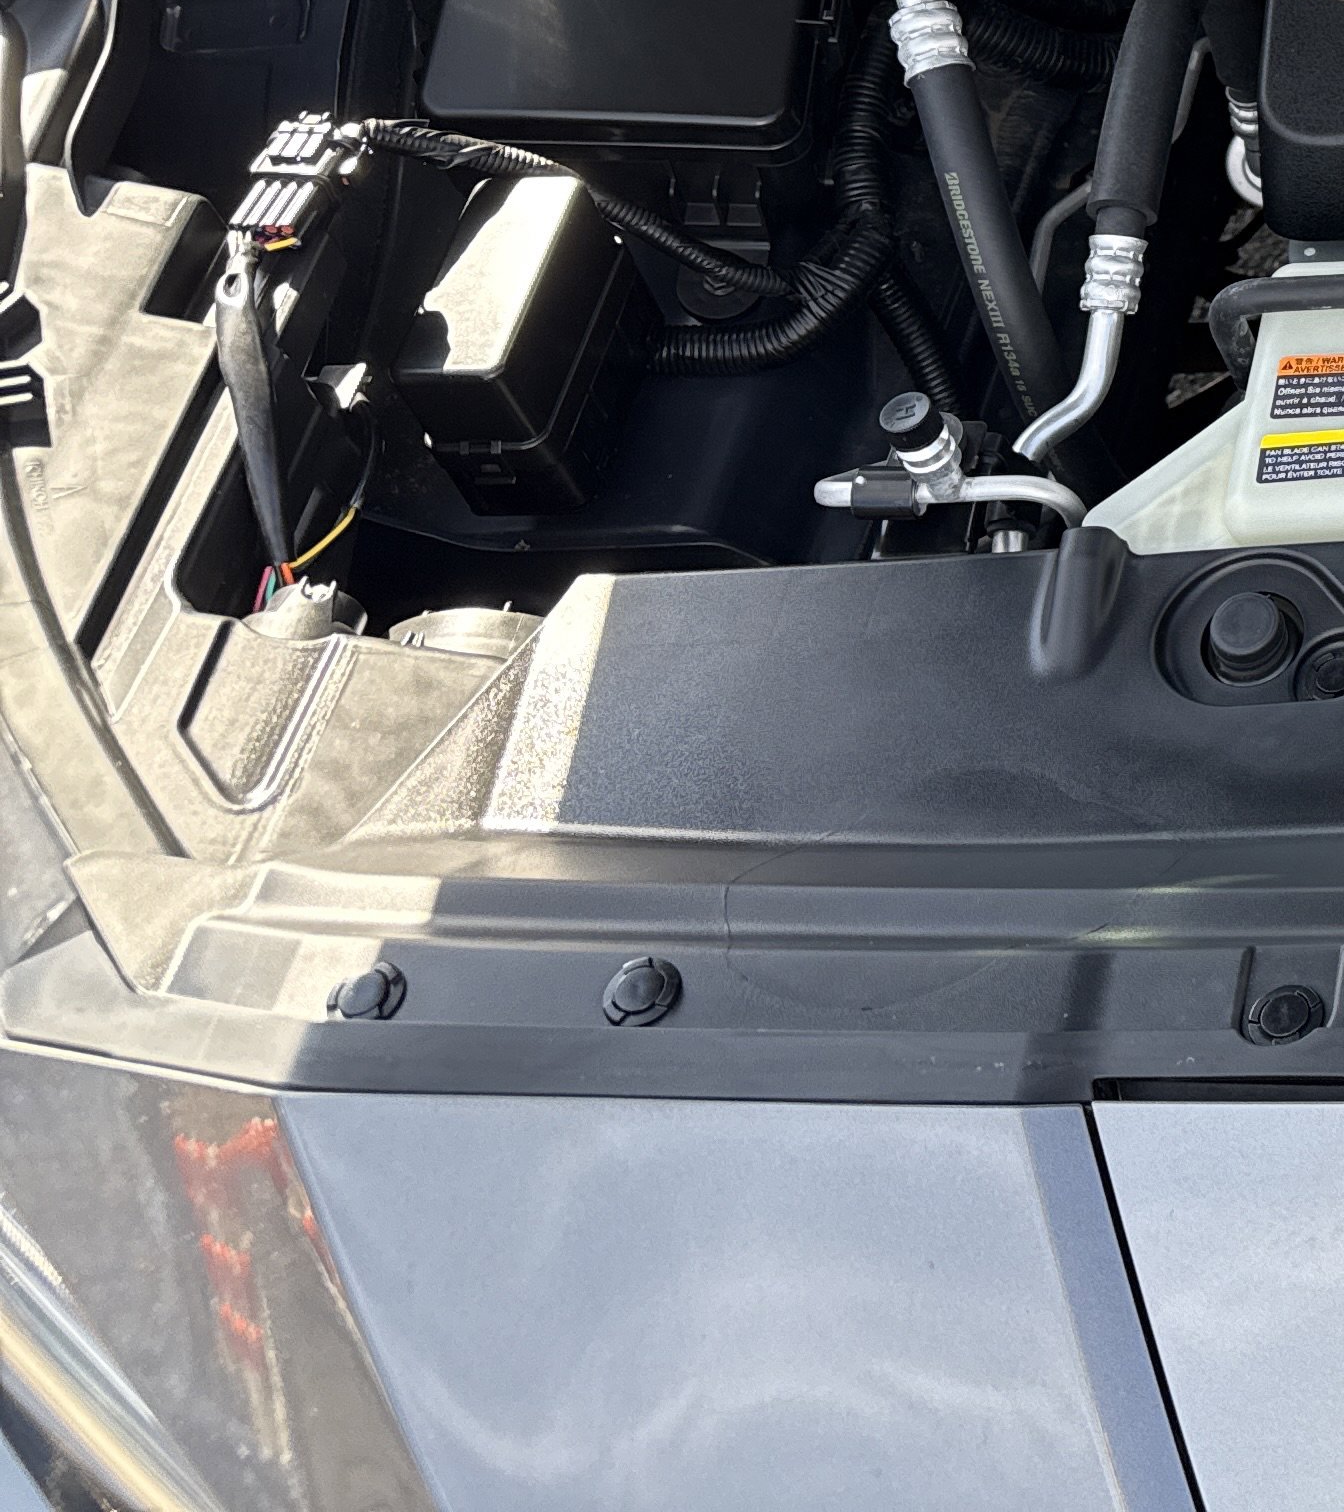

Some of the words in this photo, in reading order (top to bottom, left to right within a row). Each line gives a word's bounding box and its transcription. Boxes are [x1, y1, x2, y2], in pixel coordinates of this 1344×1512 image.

[944, 172, 986, 274] BRIDGESTONE
[977, 279, 1005, 328] NEXIII
[996, 332, 1021, 377] R134a
[1311, 445, 1329, 453] CAN
[1274, 461, 1327, 471] VENTILATEUR
[1262, 473, 1286, 481] POUR
[1316, 467, 1342, 476] TOUTE
